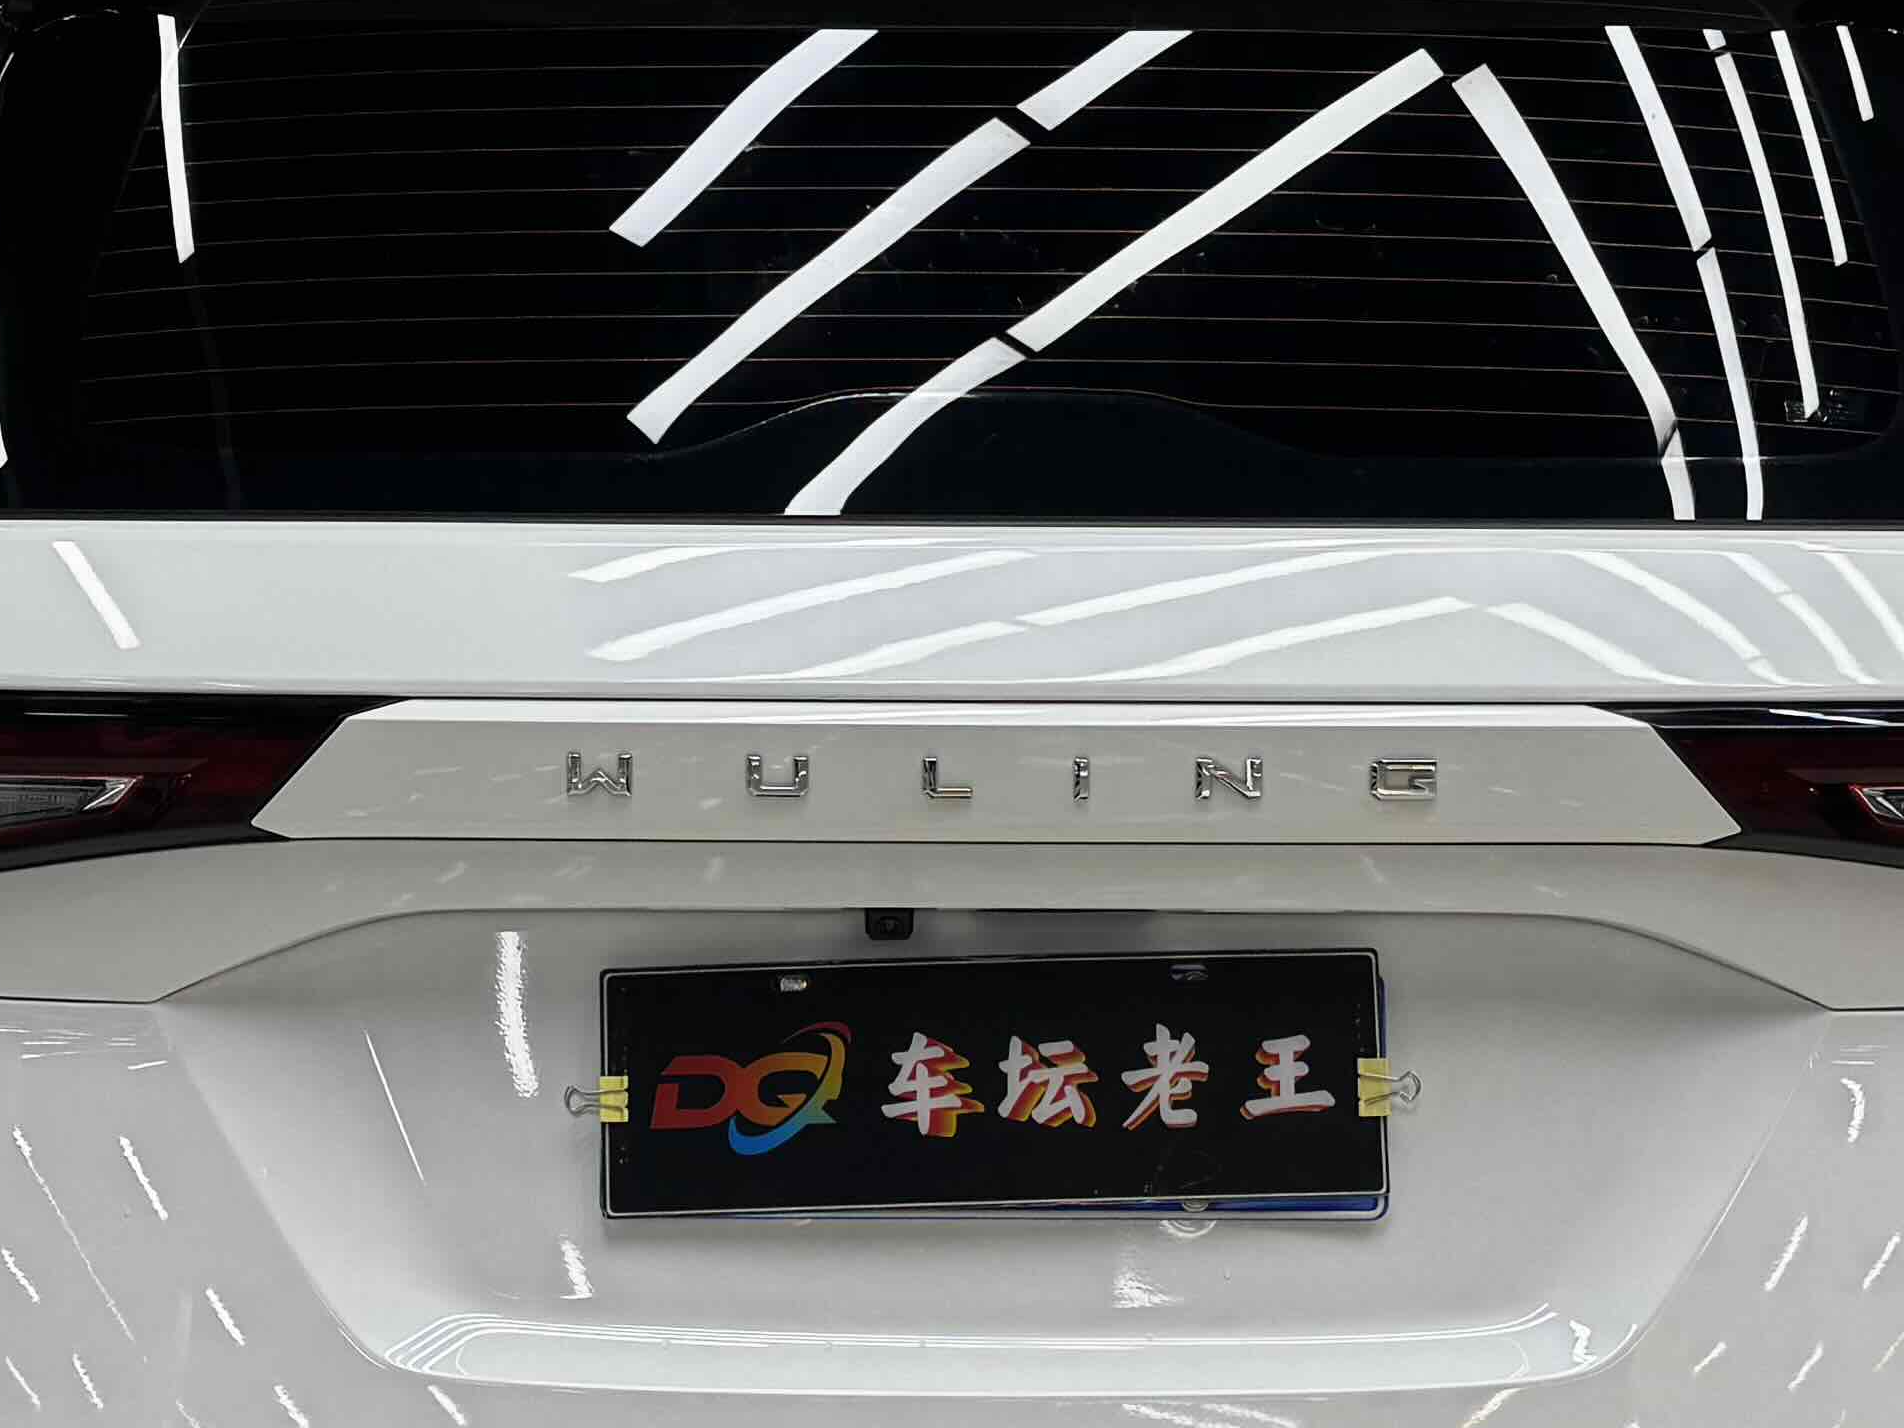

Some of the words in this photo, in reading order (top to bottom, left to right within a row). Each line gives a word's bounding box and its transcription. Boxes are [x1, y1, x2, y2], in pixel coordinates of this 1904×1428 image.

[565, 750, 1439, 801] WULING
[880, 1022, 1337, 1139] 车坛老王
